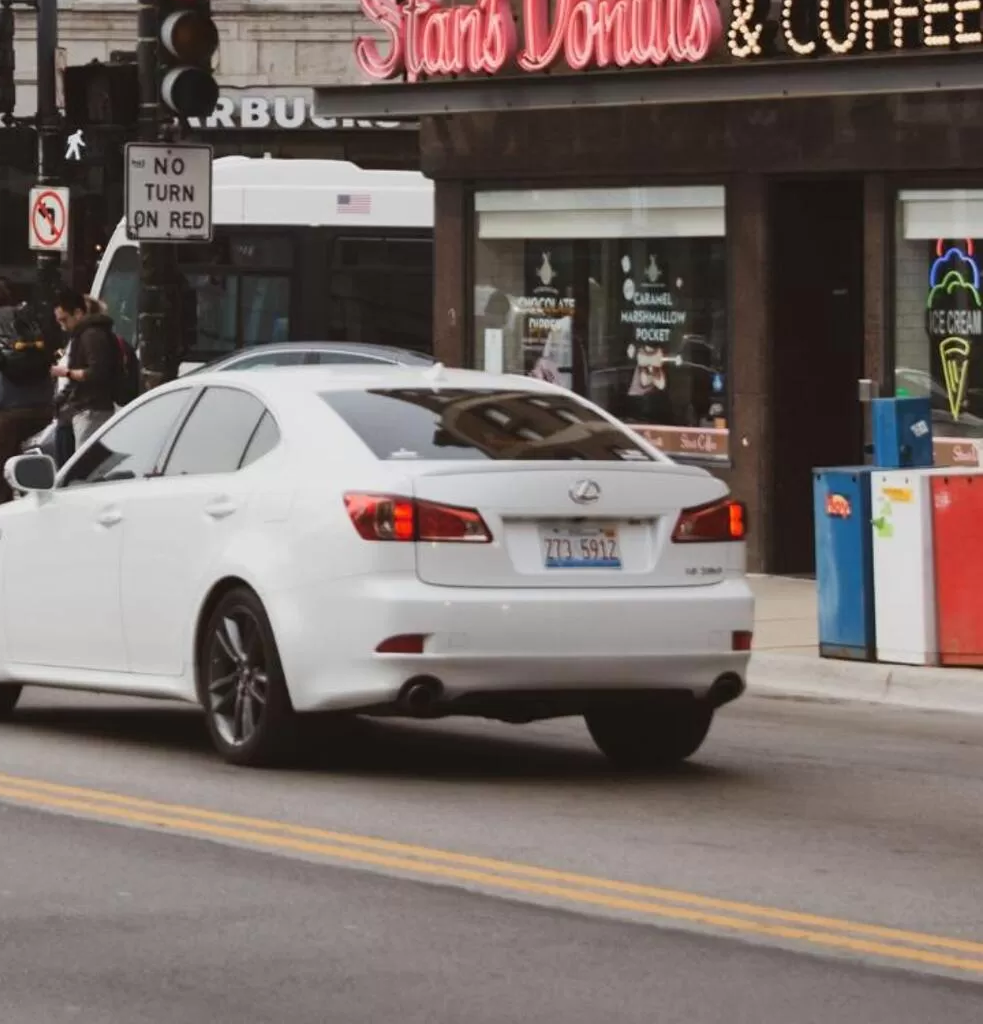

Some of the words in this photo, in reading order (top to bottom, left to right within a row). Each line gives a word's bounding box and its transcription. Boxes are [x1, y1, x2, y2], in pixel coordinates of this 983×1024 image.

[153, 157, 185, 176] NO
[144, 183, 195, 202] TURN
[134, 210, 158, 228] ON
[169, 211, 205, 229] RED
[632, 291, 673, 306] CARAMEL
[620, 309, 687, 324] MARSHMALLOW
[929, 309, 946, 334] ICE
[946, 309, 982, 334] CREAM
[635, 328, 671, 343] POCKET
[579, 538, 617, 560] 5912
